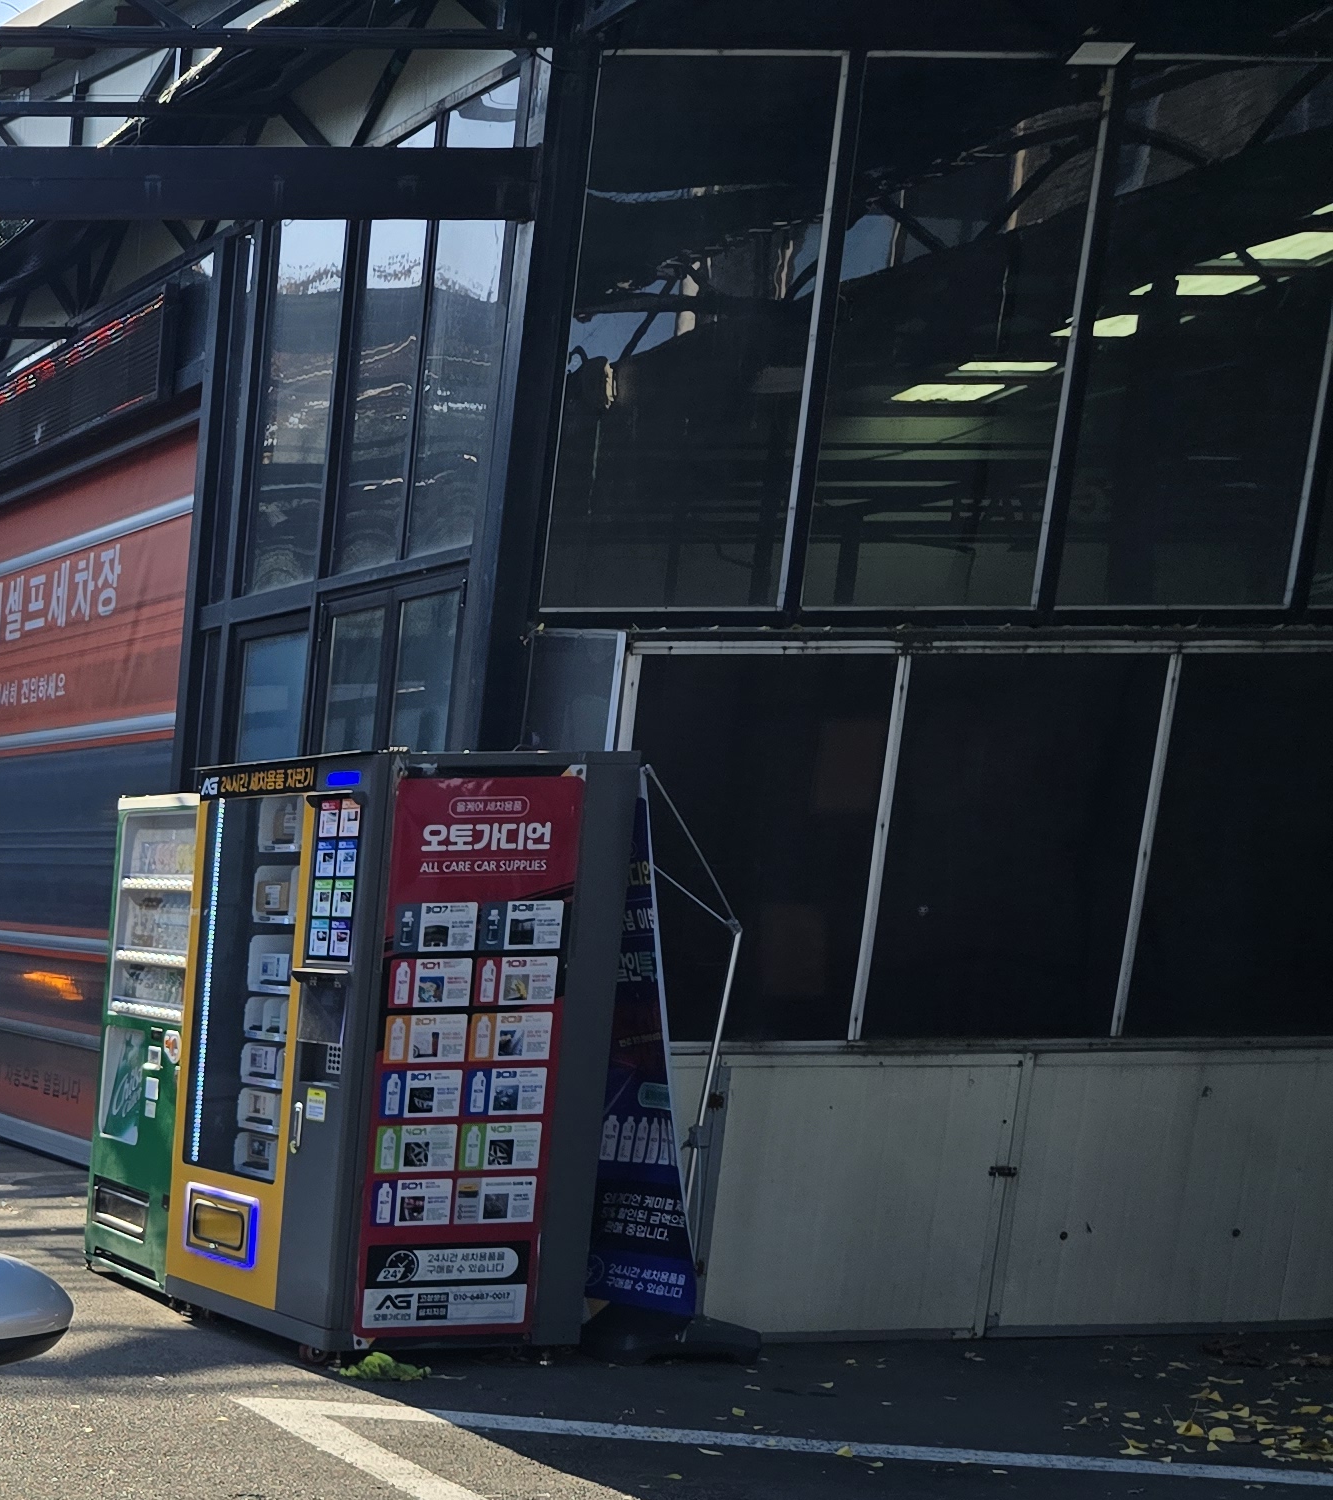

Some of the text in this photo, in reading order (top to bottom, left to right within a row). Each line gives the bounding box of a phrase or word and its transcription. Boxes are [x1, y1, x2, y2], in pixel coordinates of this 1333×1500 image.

[21, 673, 66, 704] 진입하세요
[200, 776, 219, 796] AG
[220, 766, 315, 793] 24시간 세차용품 자판기
[486, 800, 522, 812] 세차용품
[421, 821, 552, 852] 오토가디언
[420, 859, 547, 873] ALL CARE CAR SUPPLIES
[643, 1195, 674, 1211] 케미컬
[427, 1251, 506, 1264] 24시간 세차용품을
[426, 1262, 505, 1275] 구매할 수 있습니다
[608, 1262, 686, 1286] 24시간 세차용품을
[635, 1280, 645, 1292] 수
[646, 1282, 683, 1299] 있습니다
[375, 1293, 415, 1311] AG
